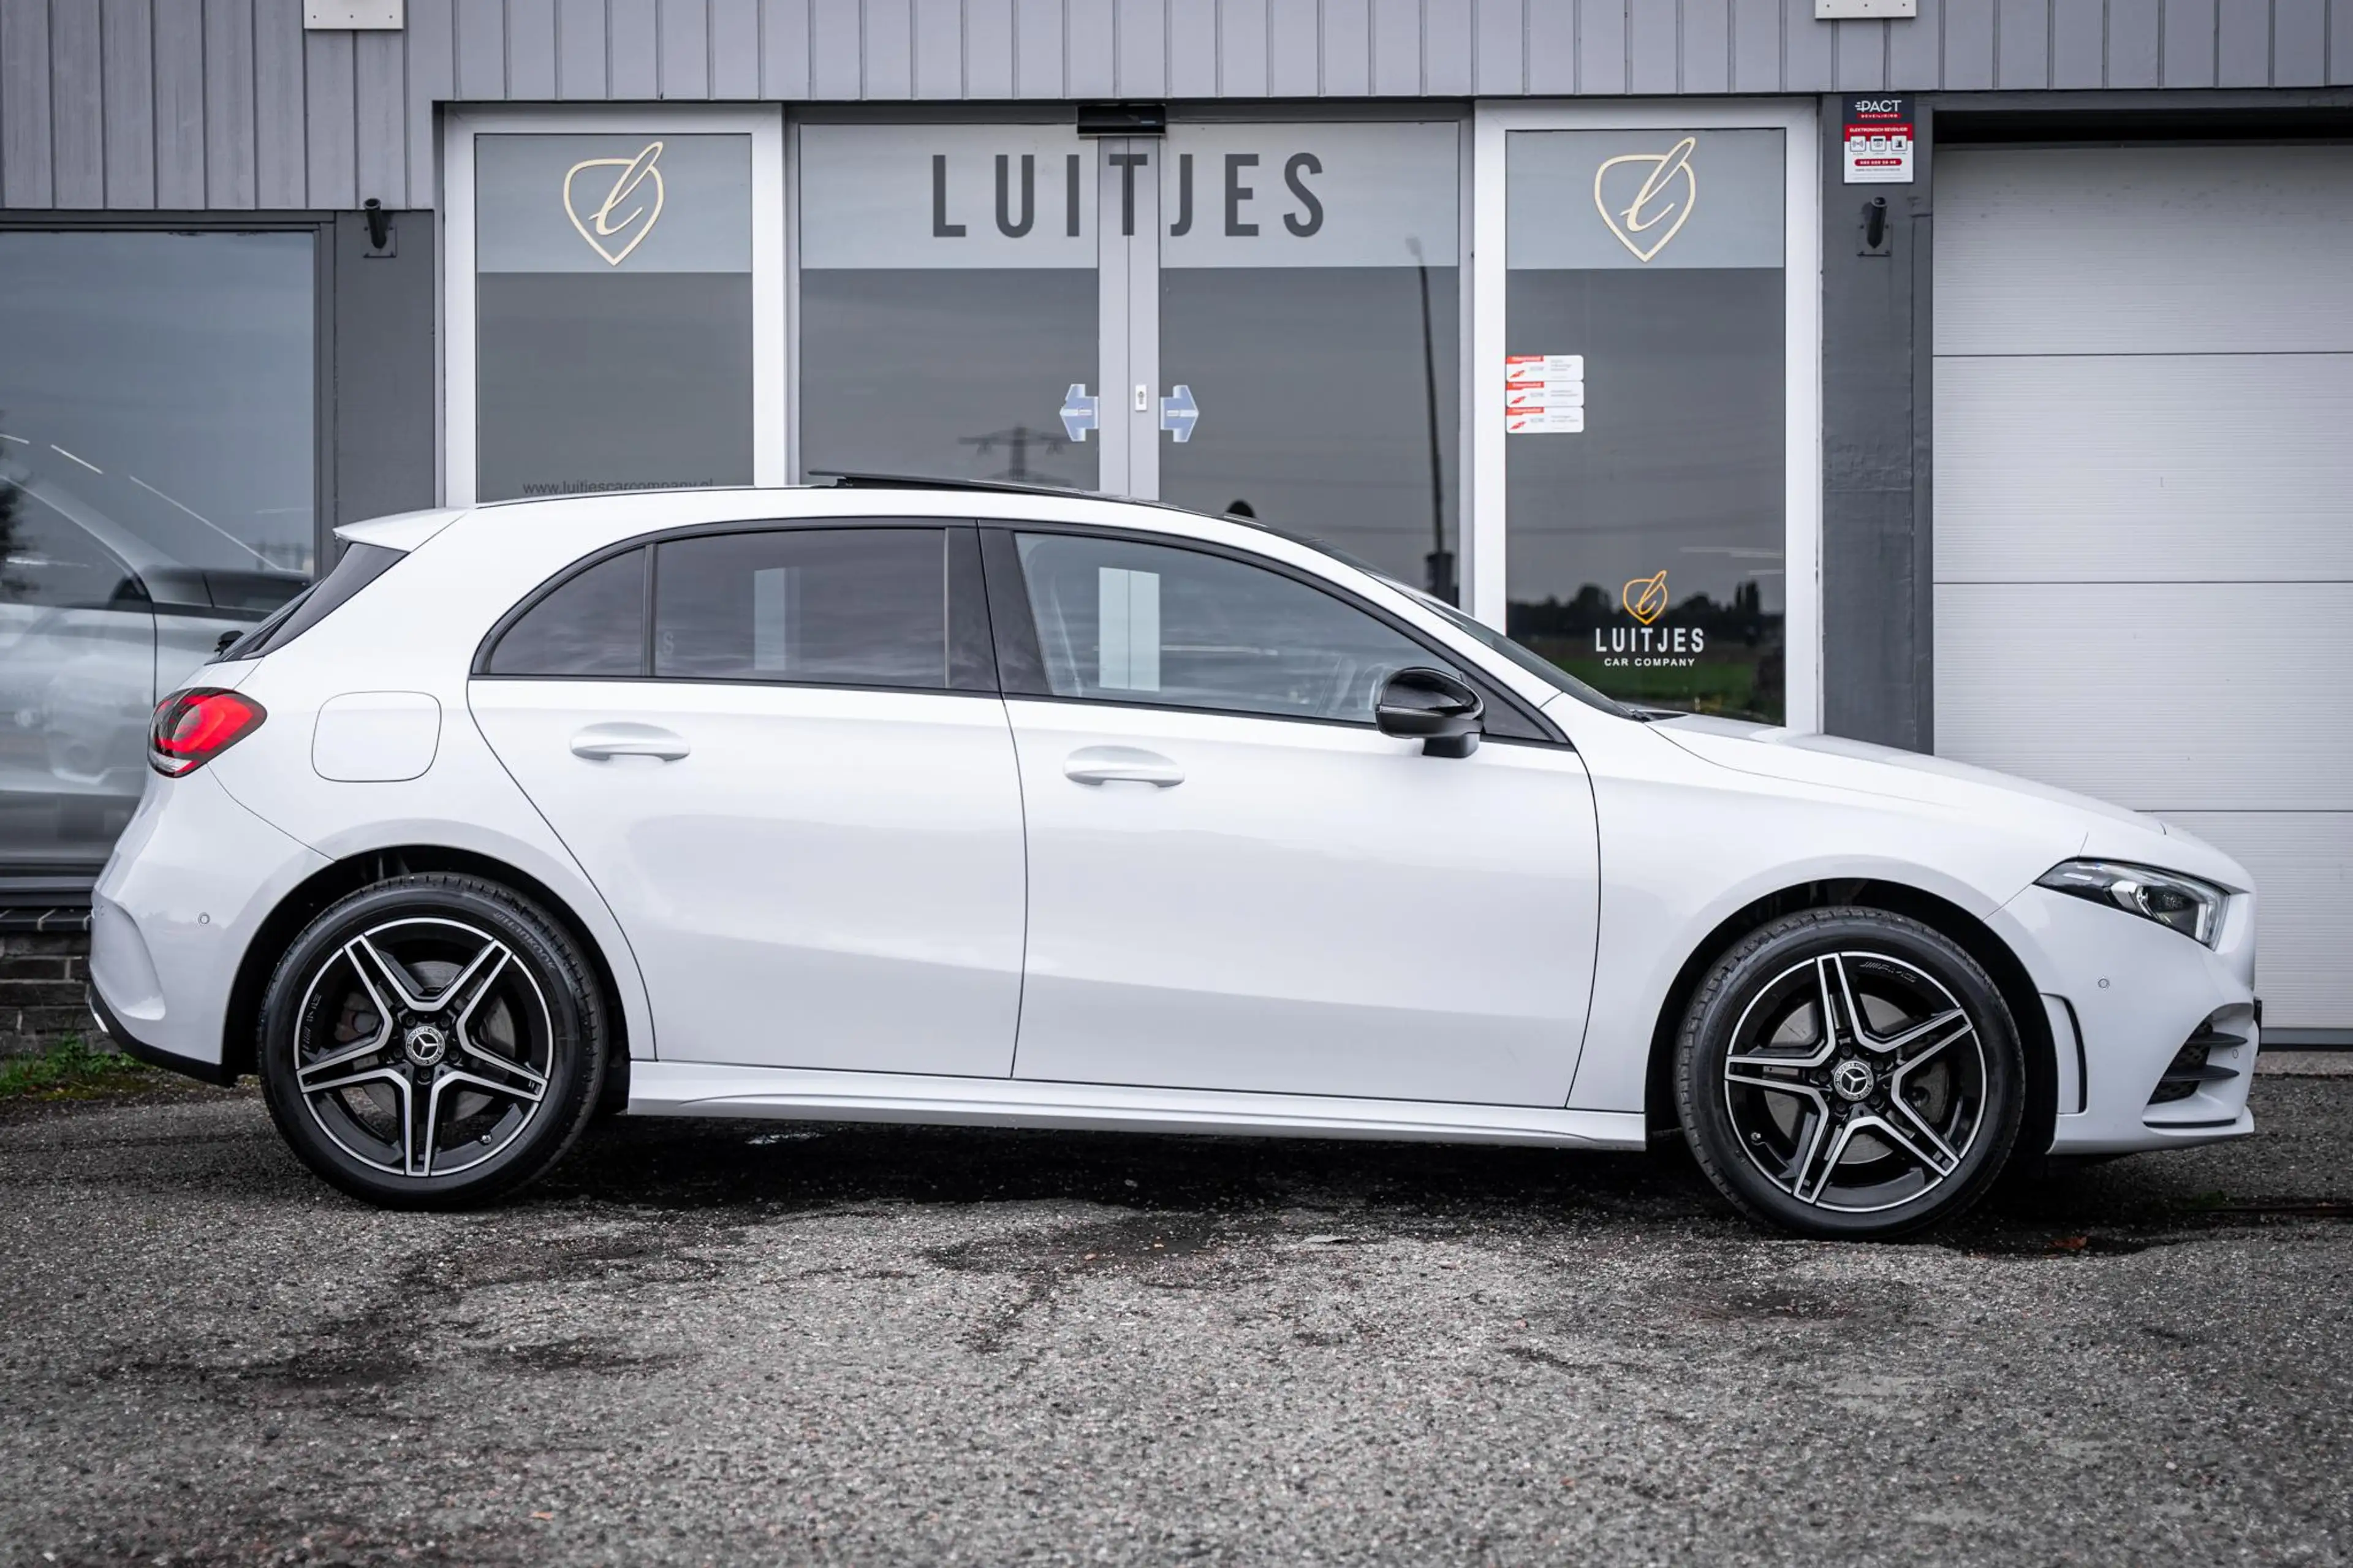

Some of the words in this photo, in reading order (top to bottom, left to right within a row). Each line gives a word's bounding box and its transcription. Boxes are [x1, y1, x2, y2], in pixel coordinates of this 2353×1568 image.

[1857, 100, 1901, 112] PACT
[933, 153, 1324, 238] LUITJES
[523, 477, 713, 494] www.luitjescarcompanl
[1596, 627, 1704, 653] LUITJES
[1604, 658, 1629, 667] CAR
[1635, 658, 1695, 667] COMPANY
